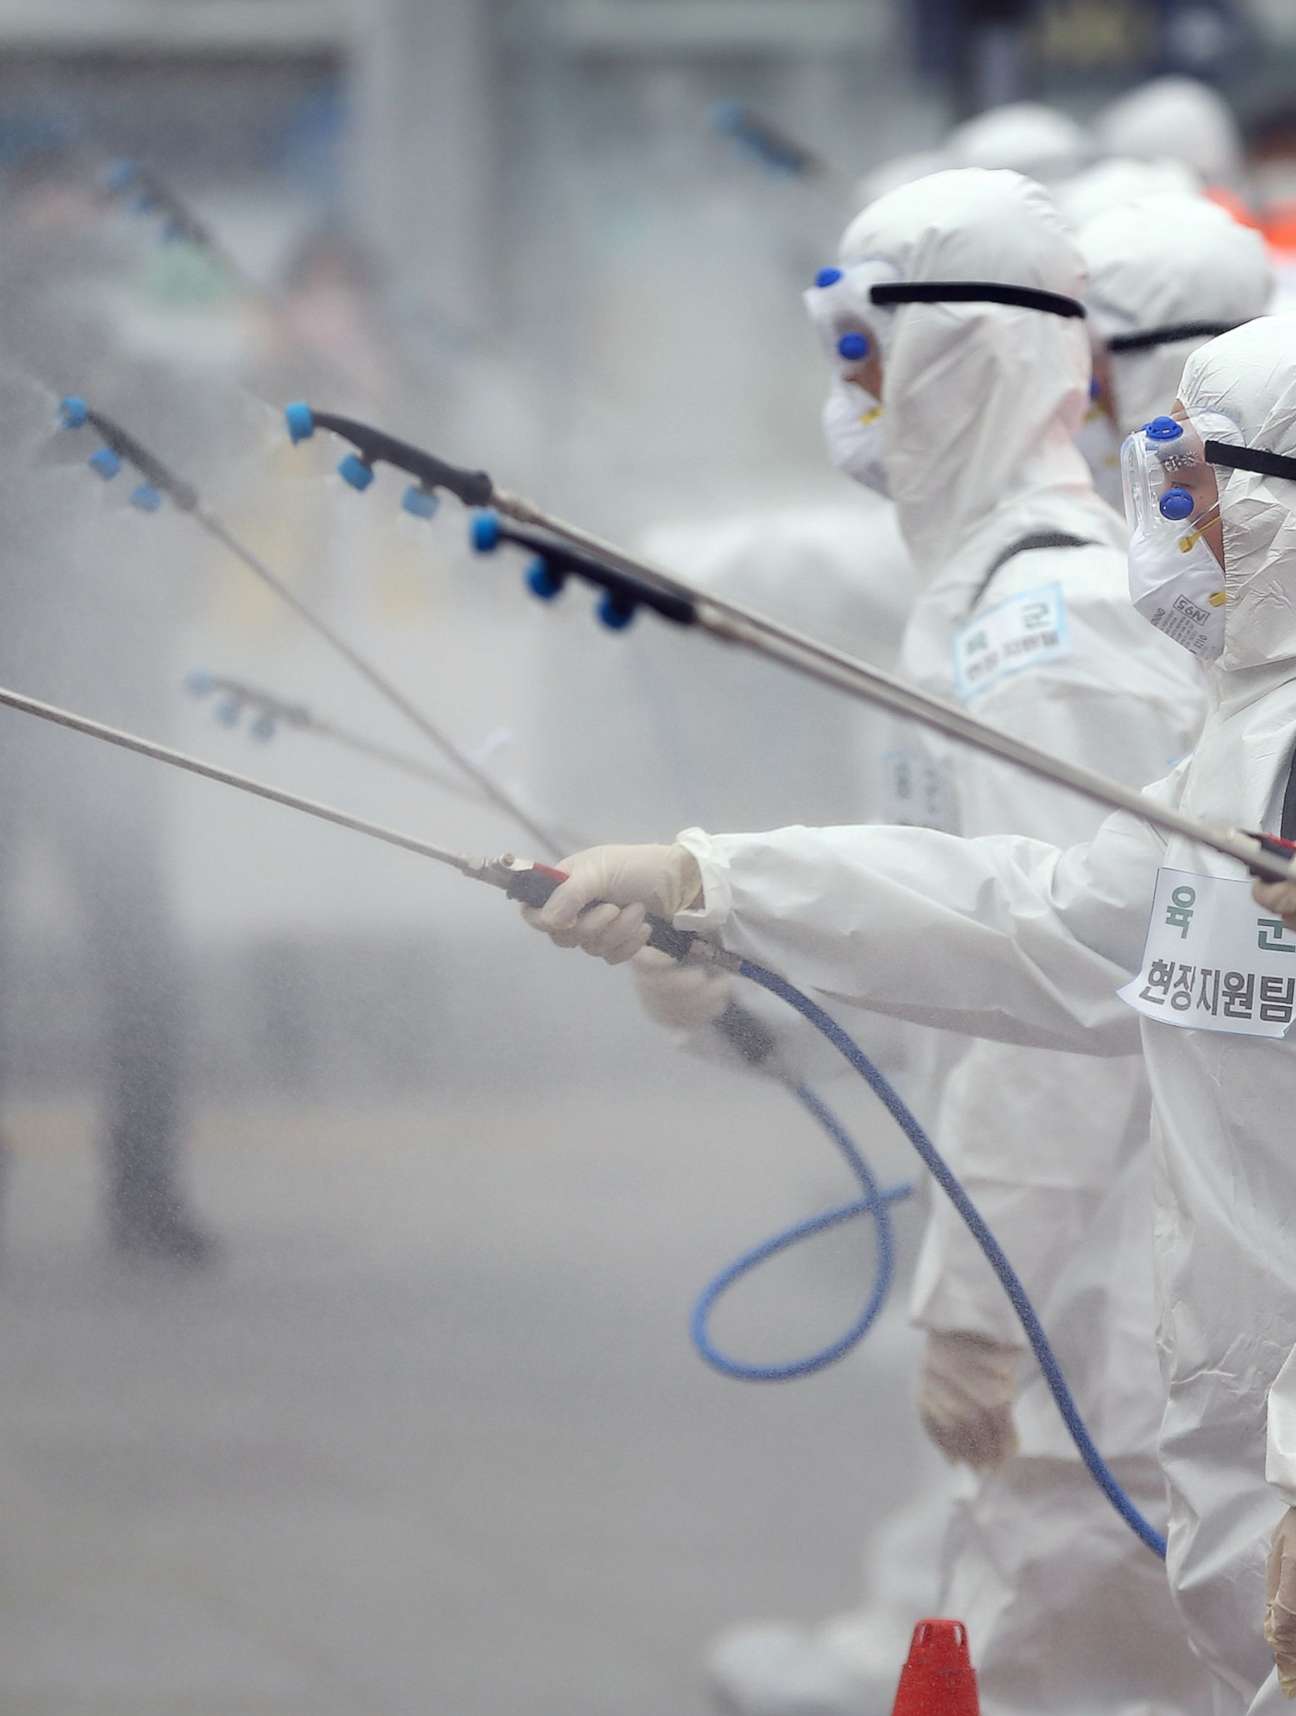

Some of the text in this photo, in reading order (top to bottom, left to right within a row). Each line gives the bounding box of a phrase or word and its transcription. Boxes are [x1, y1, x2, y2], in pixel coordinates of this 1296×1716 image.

[1177, 599, 1206, 621] N95
[1166, 885, 1296, 953] 육 군
